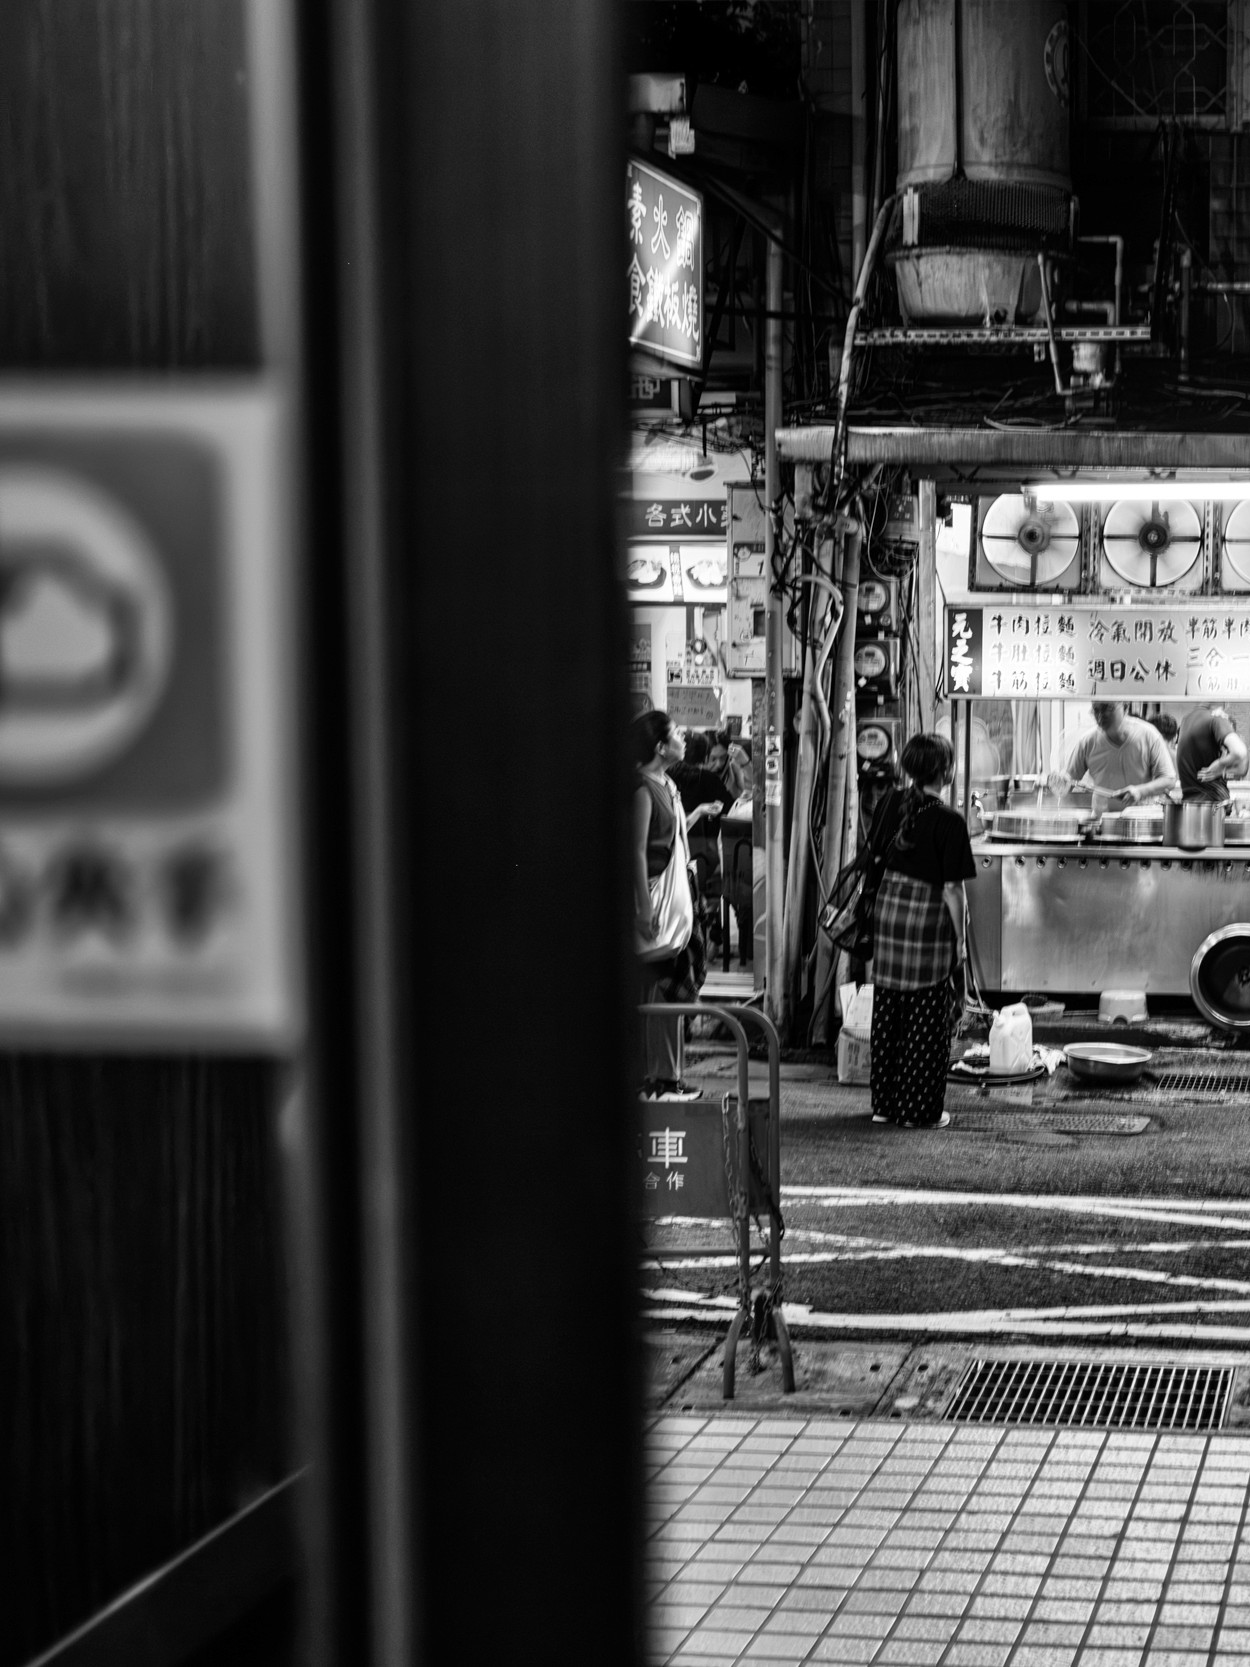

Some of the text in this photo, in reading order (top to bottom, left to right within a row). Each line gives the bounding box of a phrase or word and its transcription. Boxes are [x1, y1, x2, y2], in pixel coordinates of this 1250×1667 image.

[989, 612, 1077, 639] 牛肉拉麵
[1088, 616, 1178, 645] 冷氣開放
[989, 669, 1077, 694] 牛筋拉麵
[1087, 658, 1177, 684] 週日公休
